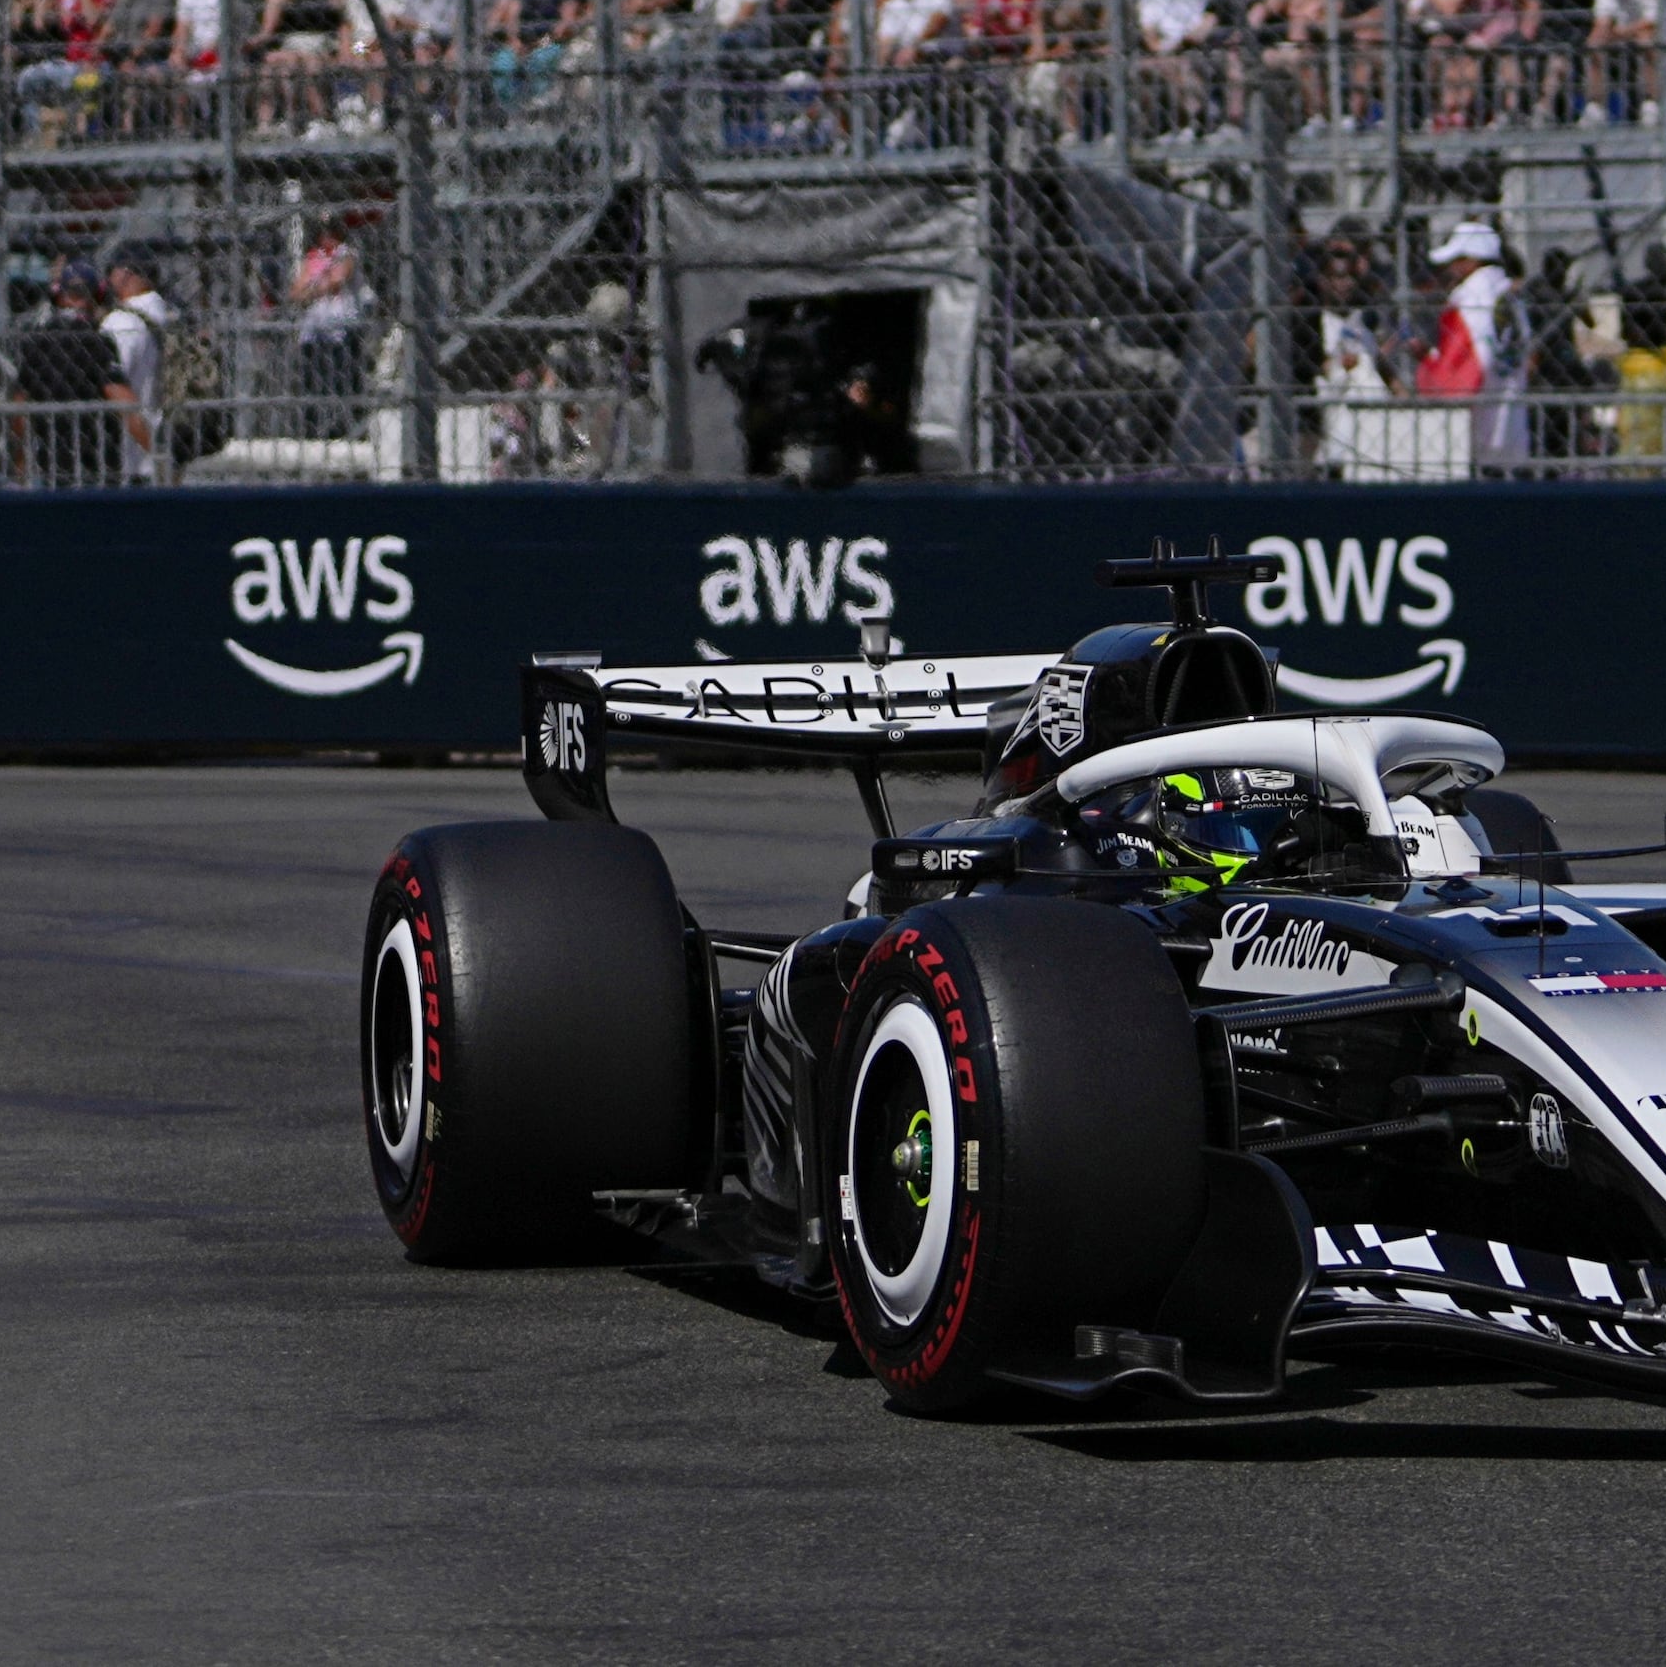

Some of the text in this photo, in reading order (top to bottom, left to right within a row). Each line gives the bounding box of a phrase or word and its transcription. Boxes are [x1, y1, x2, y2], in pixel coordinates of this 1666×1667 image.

[232, 535, 413, 622] aws
[700, 534, 894, 624] aws
[1245, 536, 1452, 626] aws
[558, 702, 586, 772] IFS
[1240, 793, 1308, 803] CADILLAC
[1400, 821, 1435, 839] BEAM
[941, 849, 974, 870] IFS
[1096, 832, 1155, 854] JIM BEAM
[1221, 903, 1349, 976] Cadillac
[1531, 969, 1651, 979] TOMMY
[414, 911, 442, 1084] ZERO
[896, 928, 978, 1103] P ZERO
